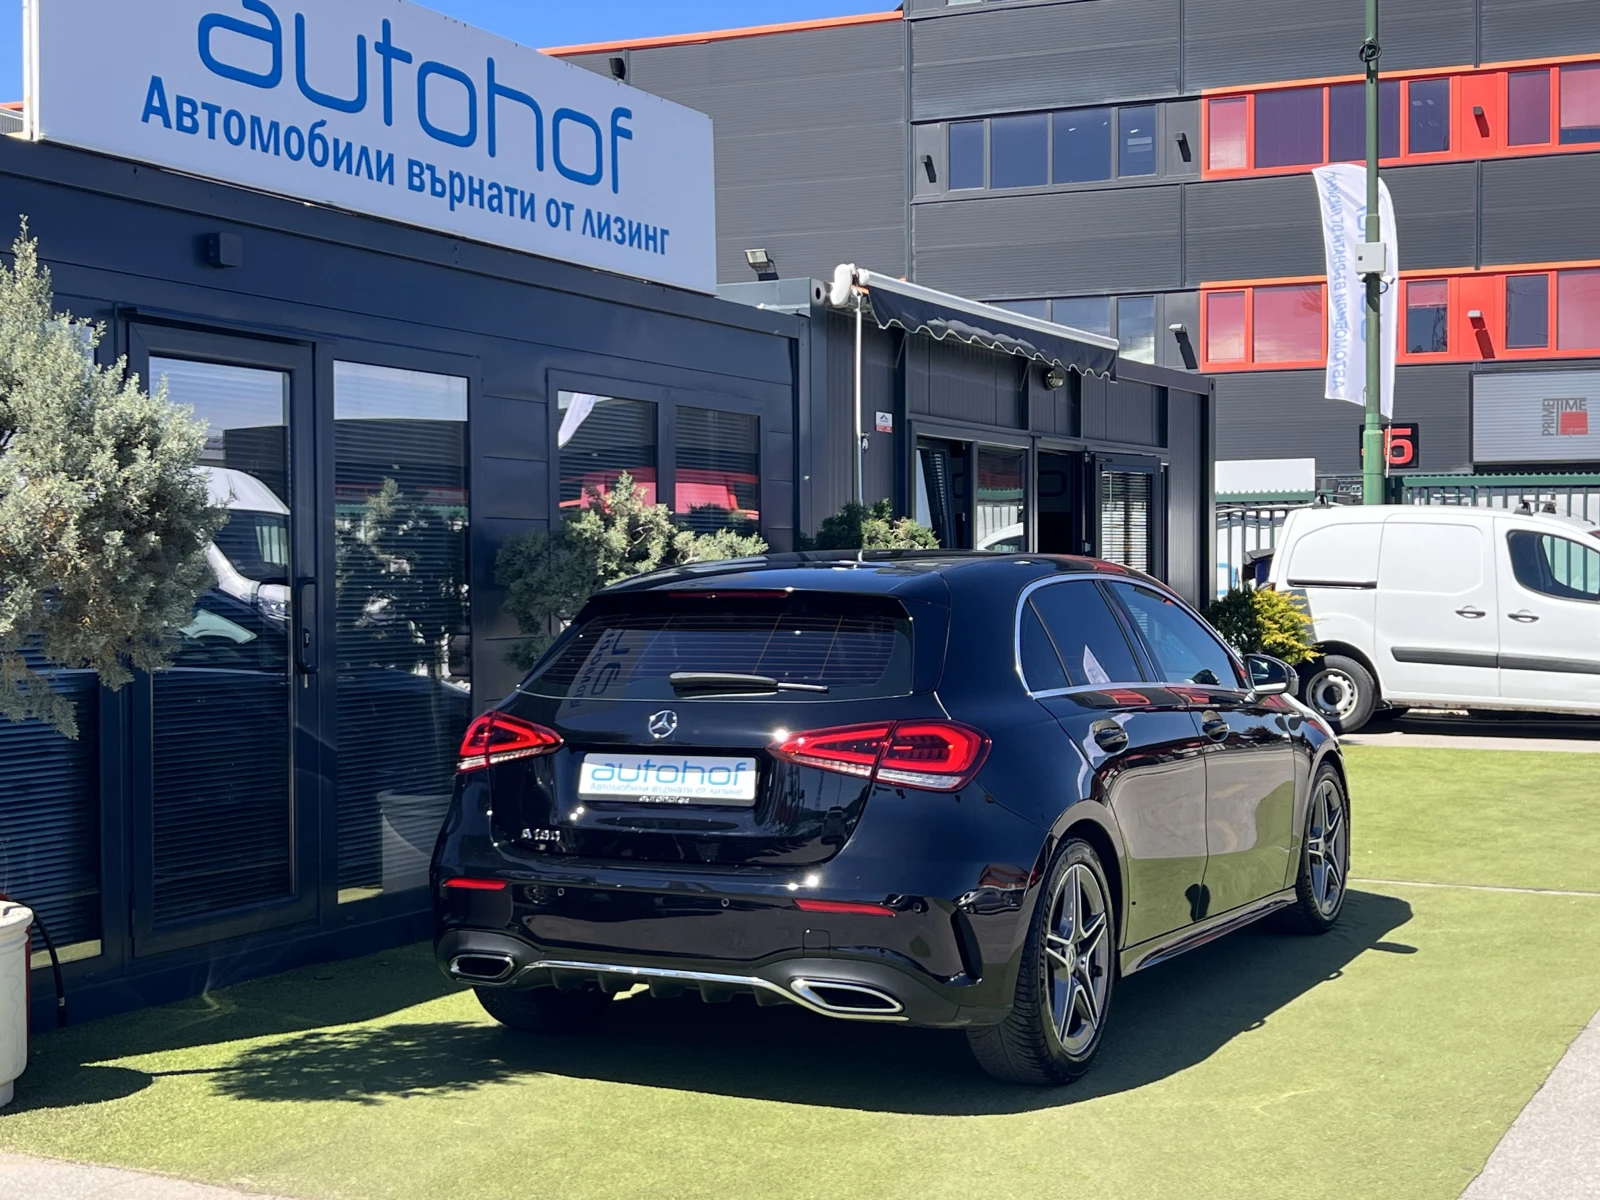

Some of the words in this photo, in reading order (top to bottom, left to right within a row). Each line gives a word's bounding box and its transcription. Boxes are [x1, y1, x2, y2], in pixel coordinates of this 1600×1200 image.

[198, 0, 633, 194] autohof
[142, 75, 395, 185] Автомобили
[408, 159, 536, 223] върнати
[546, 198, 575, 232] от
[582, 209, 670, 255] лизинг
[1542, 399, 1555, 436] PRIME
[590, 783, 649, 793] Автомобили
[652, 786, 693, 796] върнати
[696, 787, 706, 795] от
[591, 758, 748, 786] autohof
